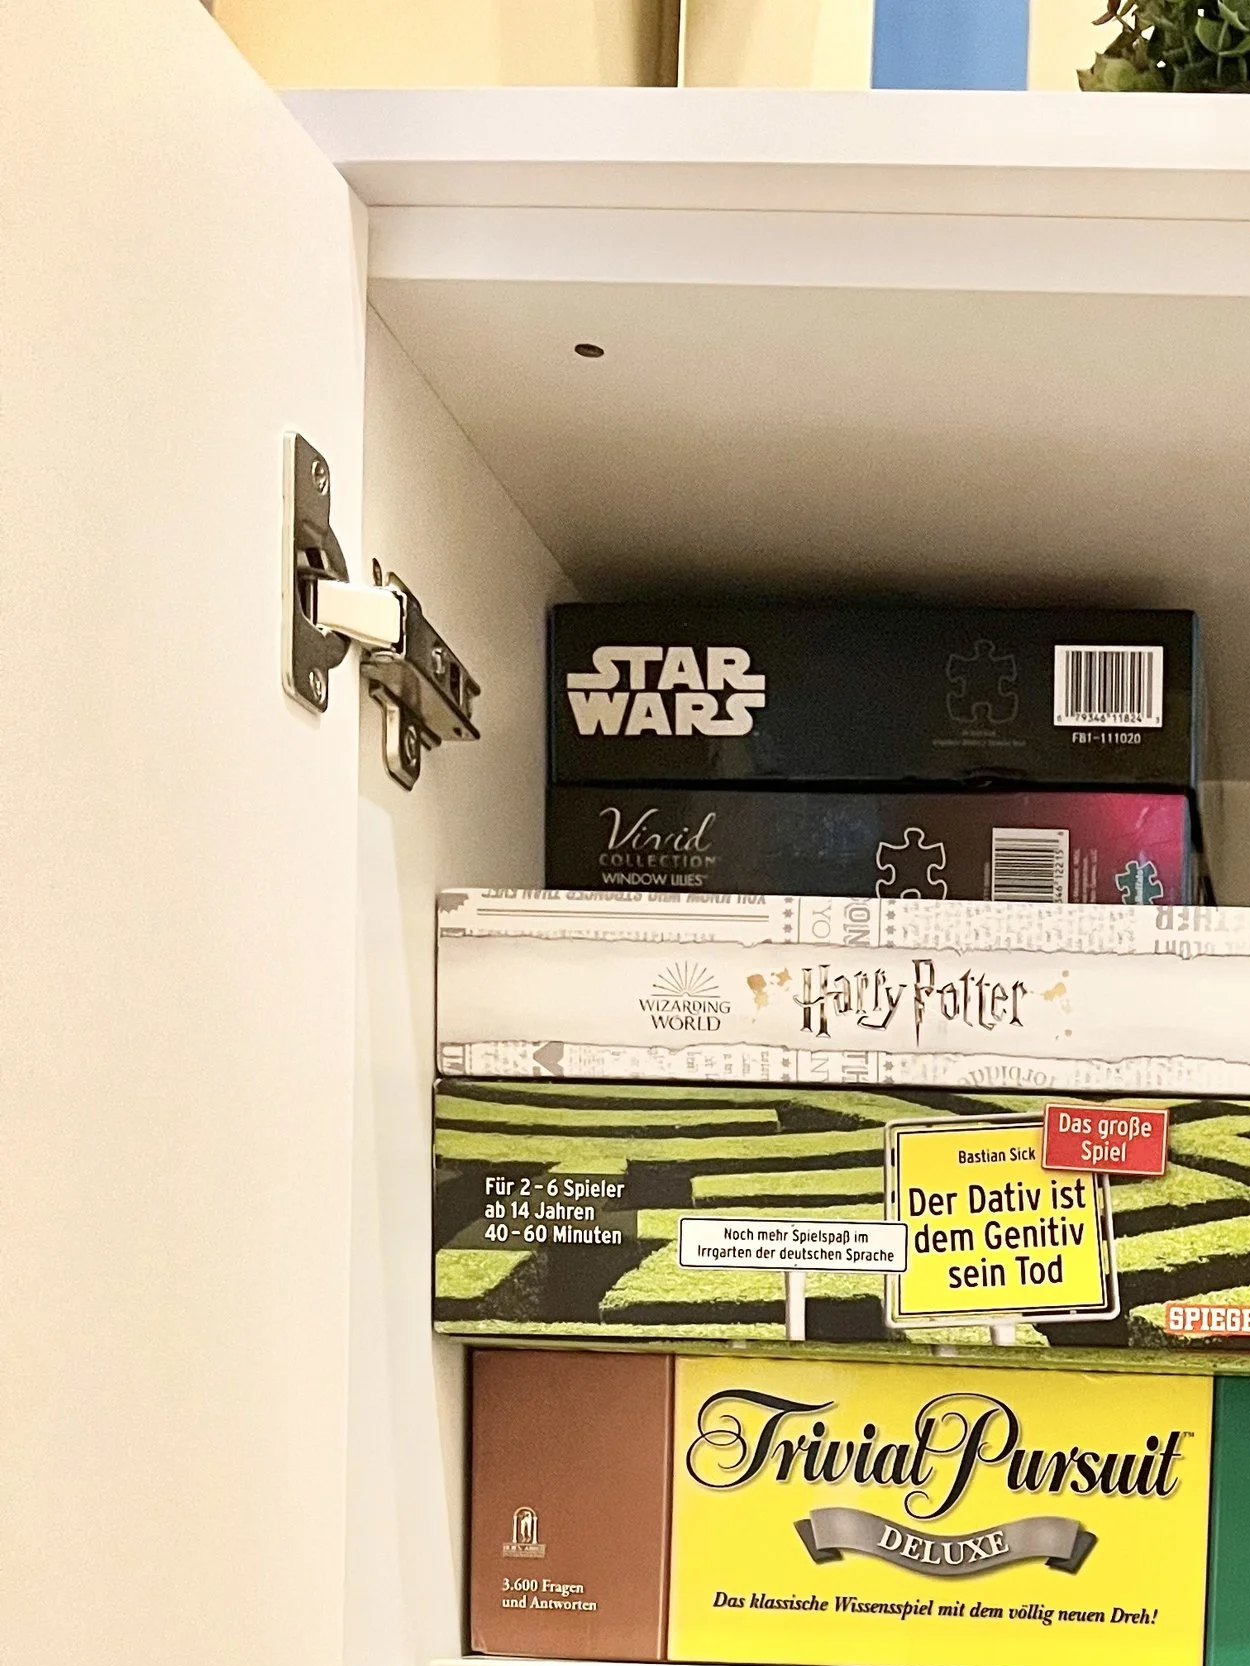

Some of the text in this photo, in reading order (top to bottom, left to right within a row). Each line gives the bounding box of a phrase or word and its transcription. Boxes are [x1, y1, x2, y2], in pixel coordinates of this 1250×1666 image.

[567, 646, 766, 690] STAR
[567, 691, 766, 736] WARS
[599, 807, 717, 852] Vivid
[599, 853, 716, 868] COLLECTION
[602, 872, 668, 886] WINDOW
[638, 998, 732, 1015] WIZARDING
[792, 958, 1029, 1047] Harry Potter
[650, 1014, 722, 1032] WORLD
[1057, 1112, 1153, 1140] Das große
[957, 1145, 1036, 1165] Bastian Sick
[1079, 1139, 1127, 1165] Spiel
[484, 1176, 625, 1200] Für Spieler
[908, 1177, 1087, 1217] Der Dativ ist
[484, 1201, 595, 1221] ab 14 Jahren
[484, 1224, 622, 1245] 40-60 Minuten
[723, 1227, 869, 1246] Noch mehr Spielspaß im
[914, 1217, 1084, 1254] dem Genitiv
[697, 1244, 895, 1265] Irrgarten der deutschen Sprache
[947, 1255, 1064, 1290] sein Tod
[686, 1388, 1180, 1521] Trivial Pursuit
[877, 1523, 1011, 1567] DELUXE
[502, 1577, 584, 1596] 3.600 Fragen
[502, 1594, 597, 1611] und Antworten
[712, 1592, 1158, 1627] Das klassische Wissensspiel mit dem völlig neuen Dreh!
